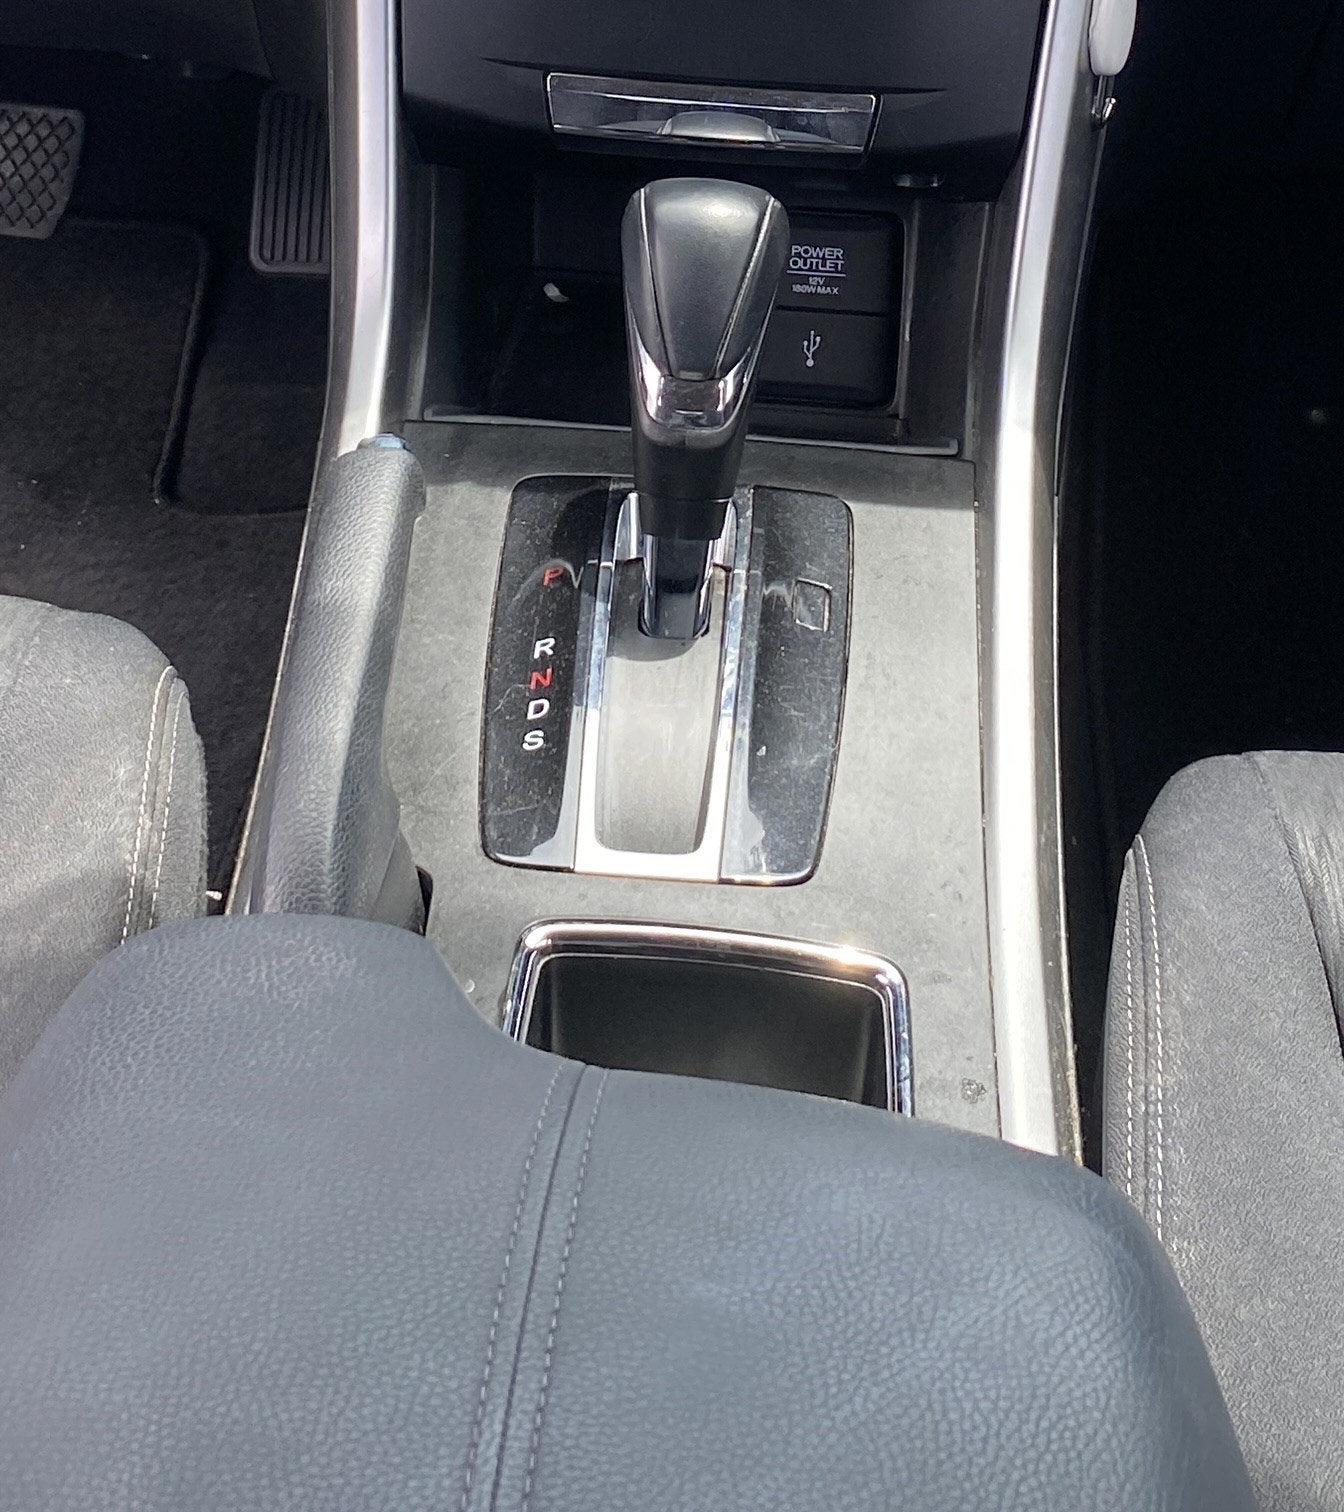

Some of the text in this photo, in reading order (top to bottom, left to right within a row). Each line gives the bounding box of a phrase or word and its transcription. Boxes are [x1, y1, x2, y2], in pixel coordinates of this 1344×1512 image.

[791, 245, 844, 260] POWER
[789, 257, 845, 271] OUTLET
[808, 276, 825, 285] 12V
[543, 566, 564, 586] P
[533, 637, 555, 659] R
[530, 667, 553, 689] N
[526, 697, 550, 721] D
[522, 729, 545, 751] S
